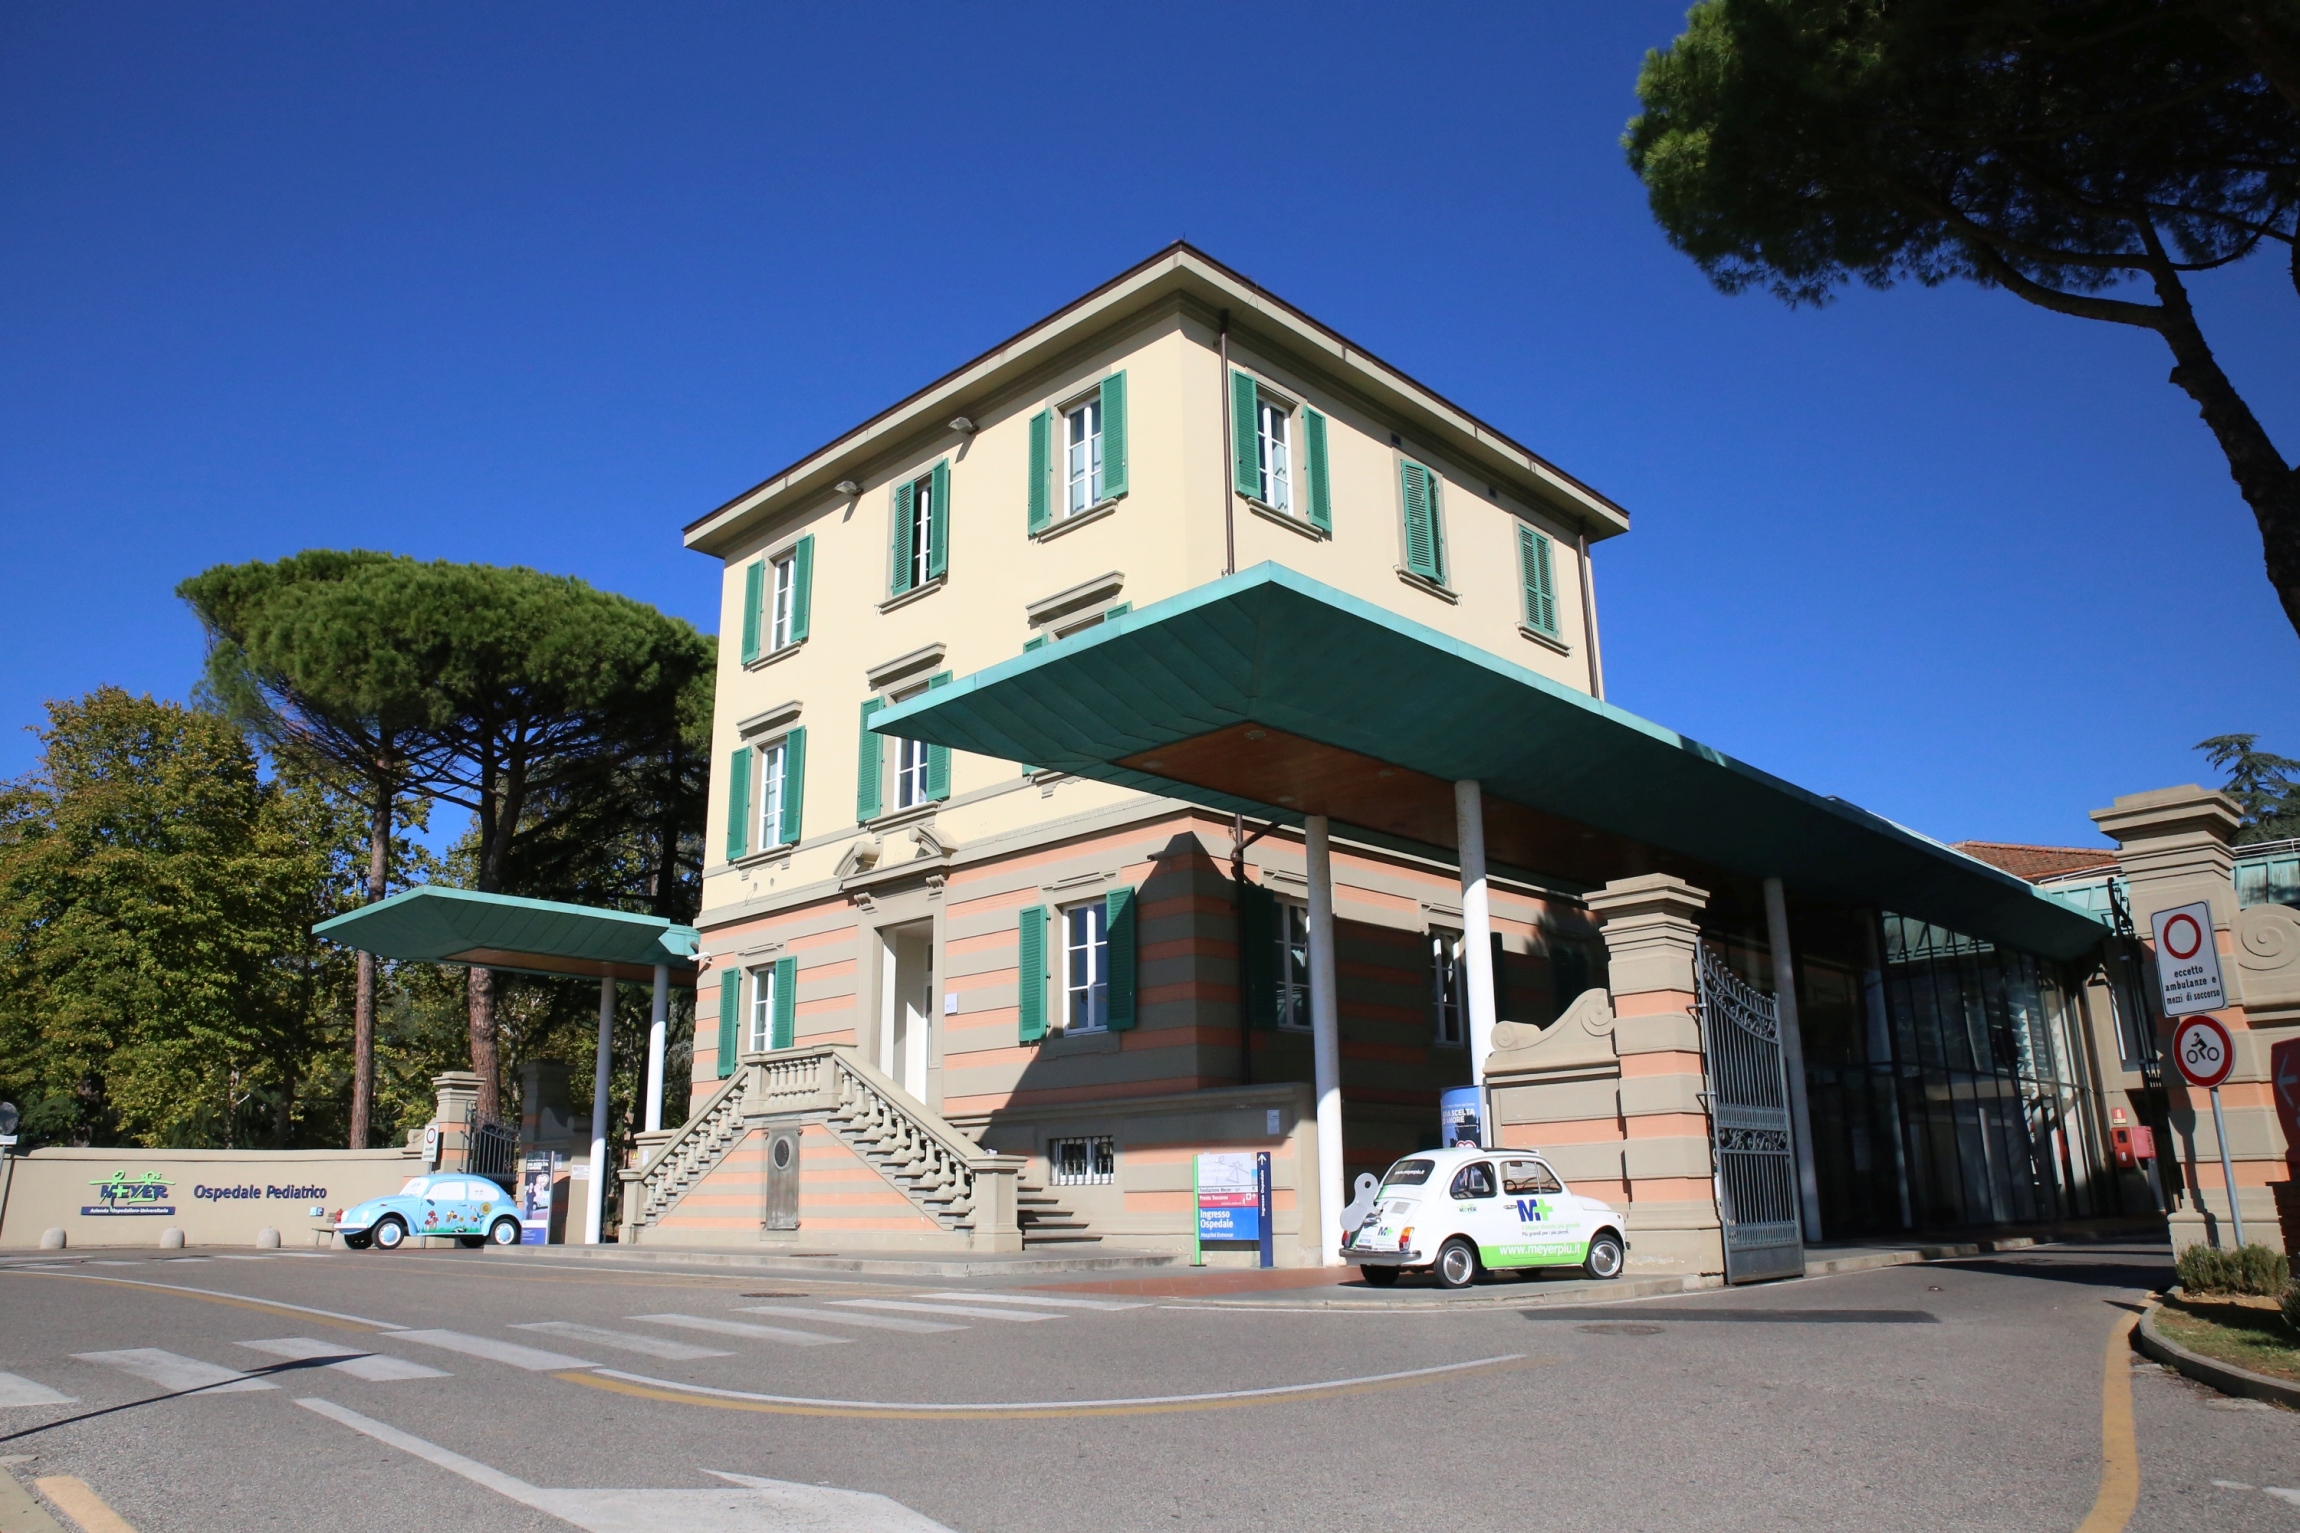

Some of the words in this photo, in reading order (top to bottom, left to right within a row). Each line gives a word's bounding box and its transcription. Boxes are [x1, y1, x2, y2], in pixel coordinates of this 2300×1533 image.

[2174, 965, 2203, 978] eccetto
[2165, 977, 2207, 991] ambulanze
[2166, 993, 2183, 1004] mezzi
[2186, 991, 2192, 1001] di
[2193, 989, 2220, 1001] soccorso
[1451, 1108, 1476, 1117] SCELTA
[100, 1184, 169, 1199] MEYER
[193, 1184, 261, 1202] Ospedale
[266, 1183, 328, 1199] Pediatrico
[1200, 1209, 1230, 1220] Ingresso
[1200, 1219, 1234, 1230] Ospedale
[1499, 1243, 1581, 1256] www.meyerpiu.it
